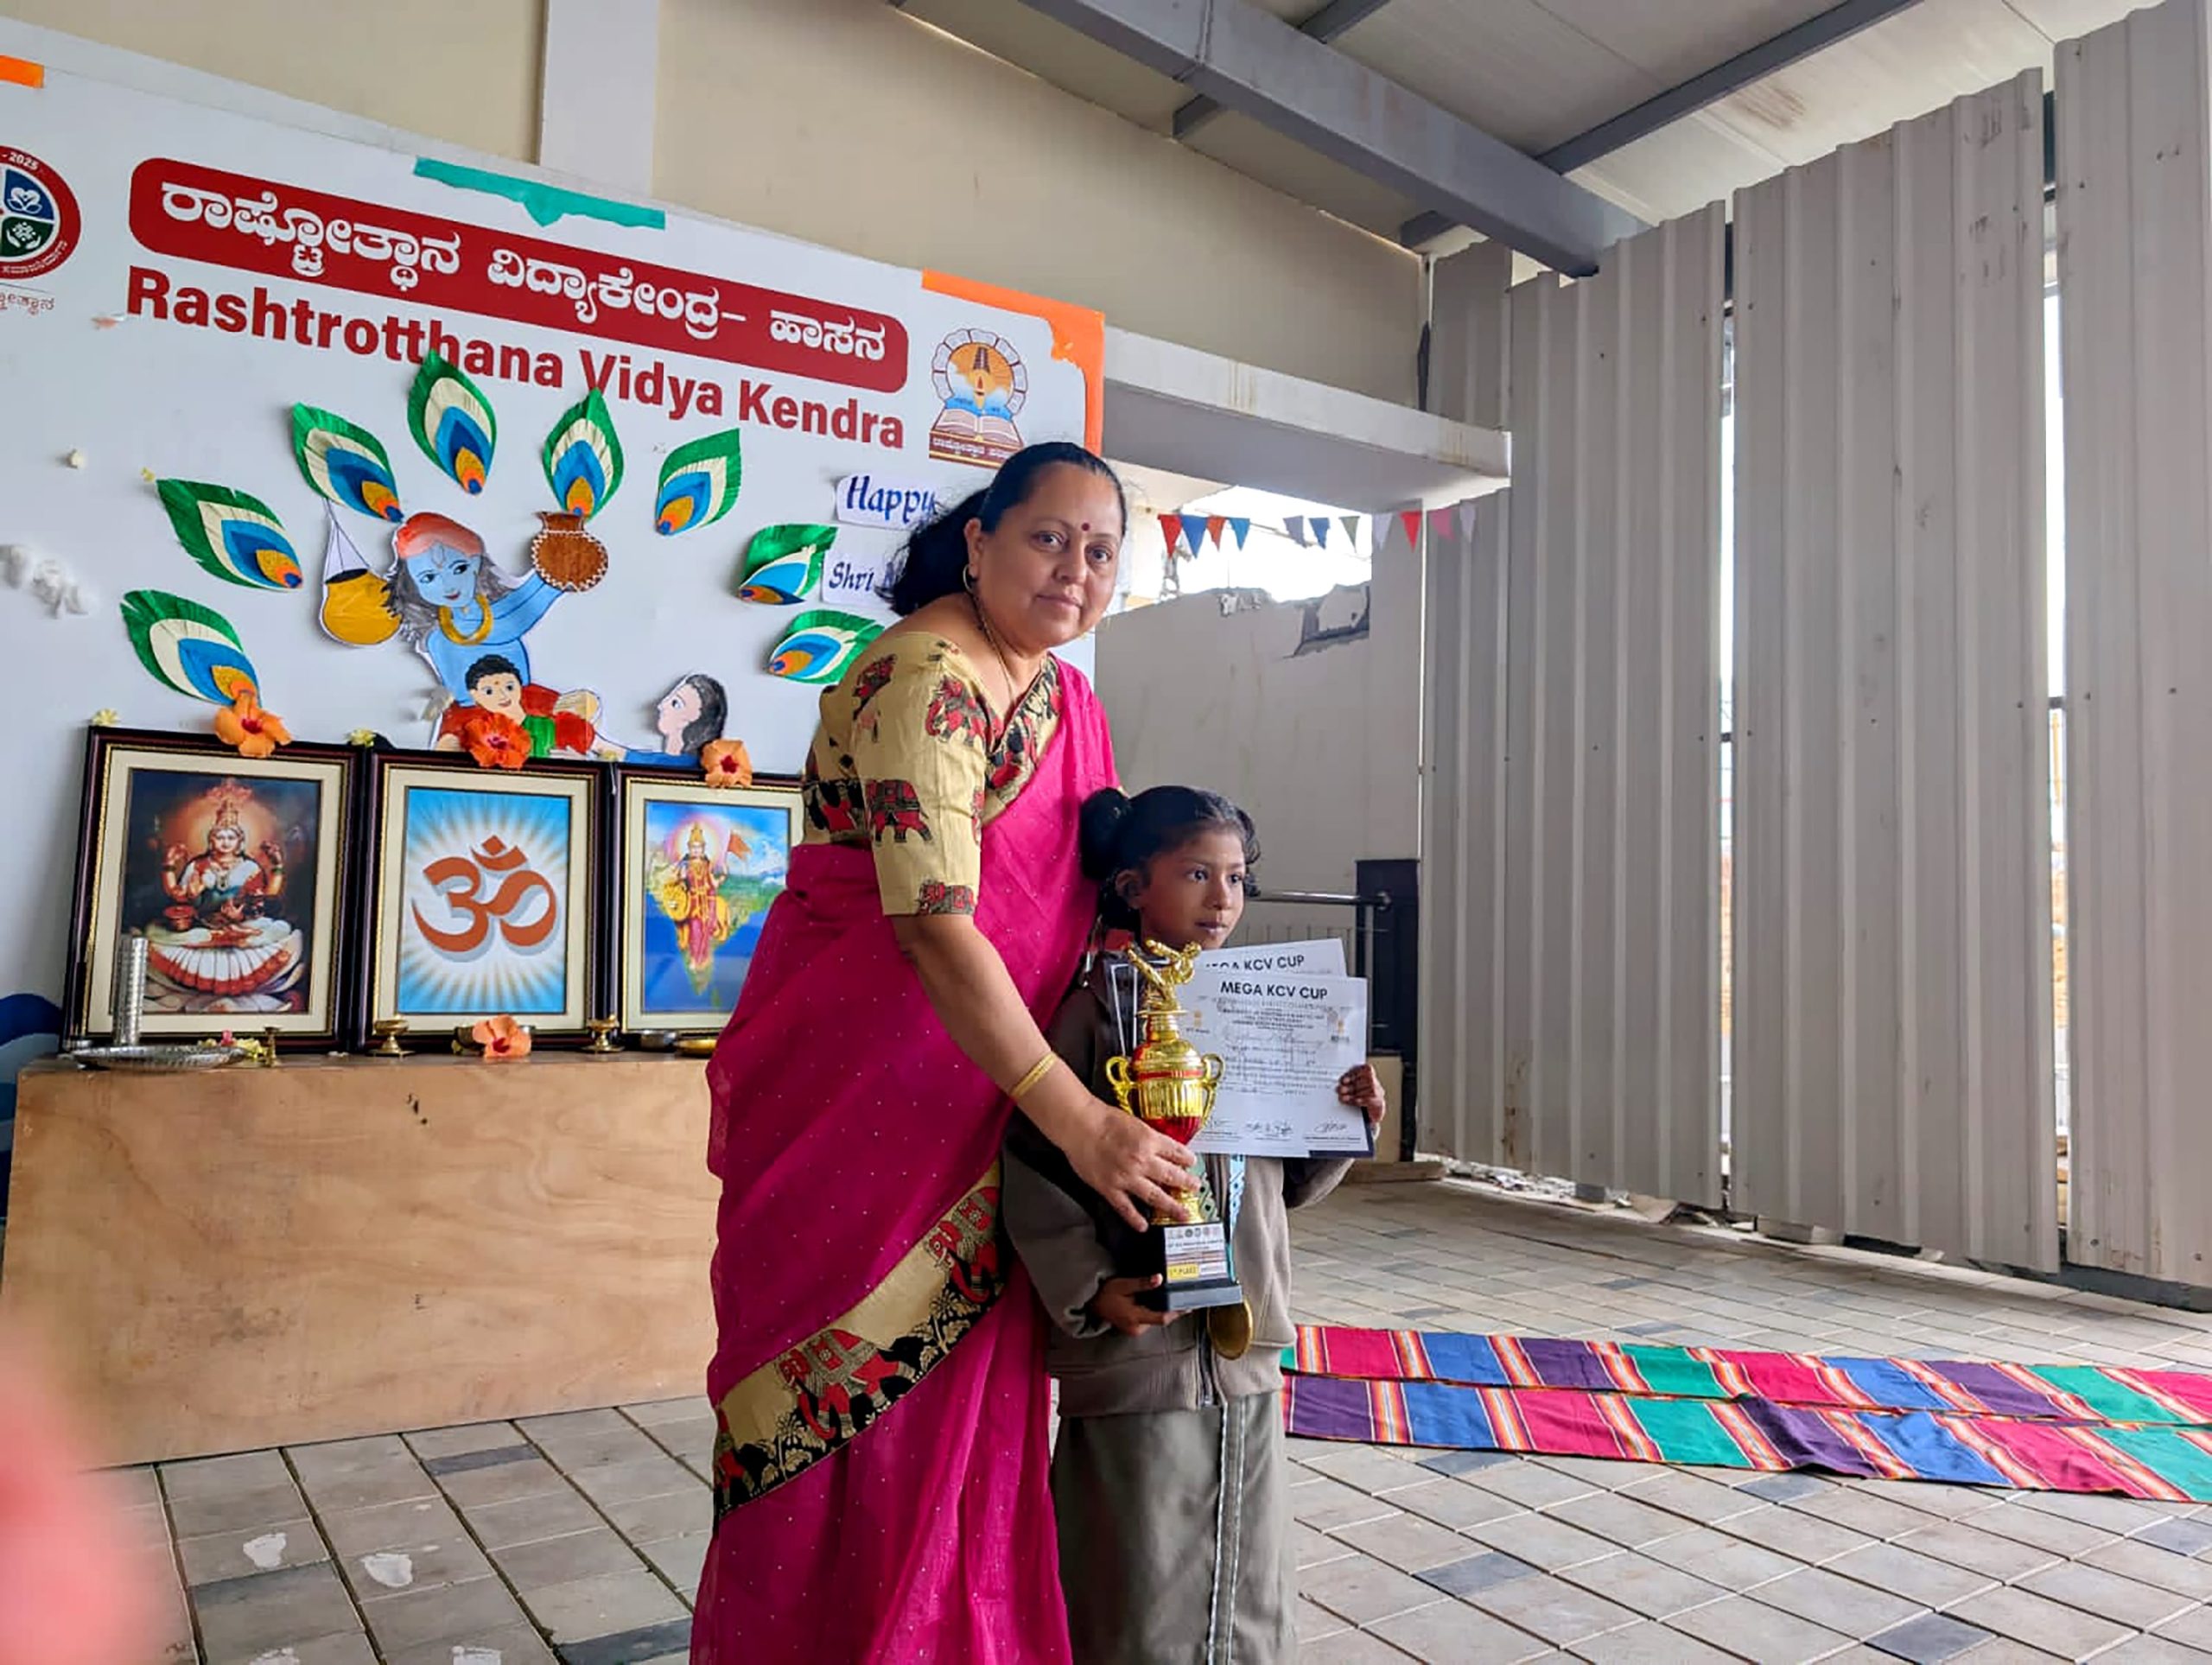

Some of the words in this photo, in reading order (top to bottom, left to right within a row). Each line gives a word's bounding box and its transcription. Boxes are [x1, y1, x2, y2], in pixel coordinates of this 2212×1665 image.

[10, 152, 39, 169] 2025
[161, 182, 461, 291] ರಾಷ್ಟ್ರೋತ್ಥಾನ
[769, 309, 886, 361] ಹಾಸನ
[127, 265, 563, 388] Rashtrotthana
[579, 349, 722, 421] Vidya
[739, 379, 904, 448] Kendra
[847, 475, 936, 531] Happy
[829, 561, 874, 591] Shri
[1244, 958, 1273, 970] KCV
[1277, 955, 1305, 968] CUP
[1220, 981, 1262, 995] MEGA
[1267, 984, 1296, 997] KCV
[1300, 986, 1328, 1000] CUP
